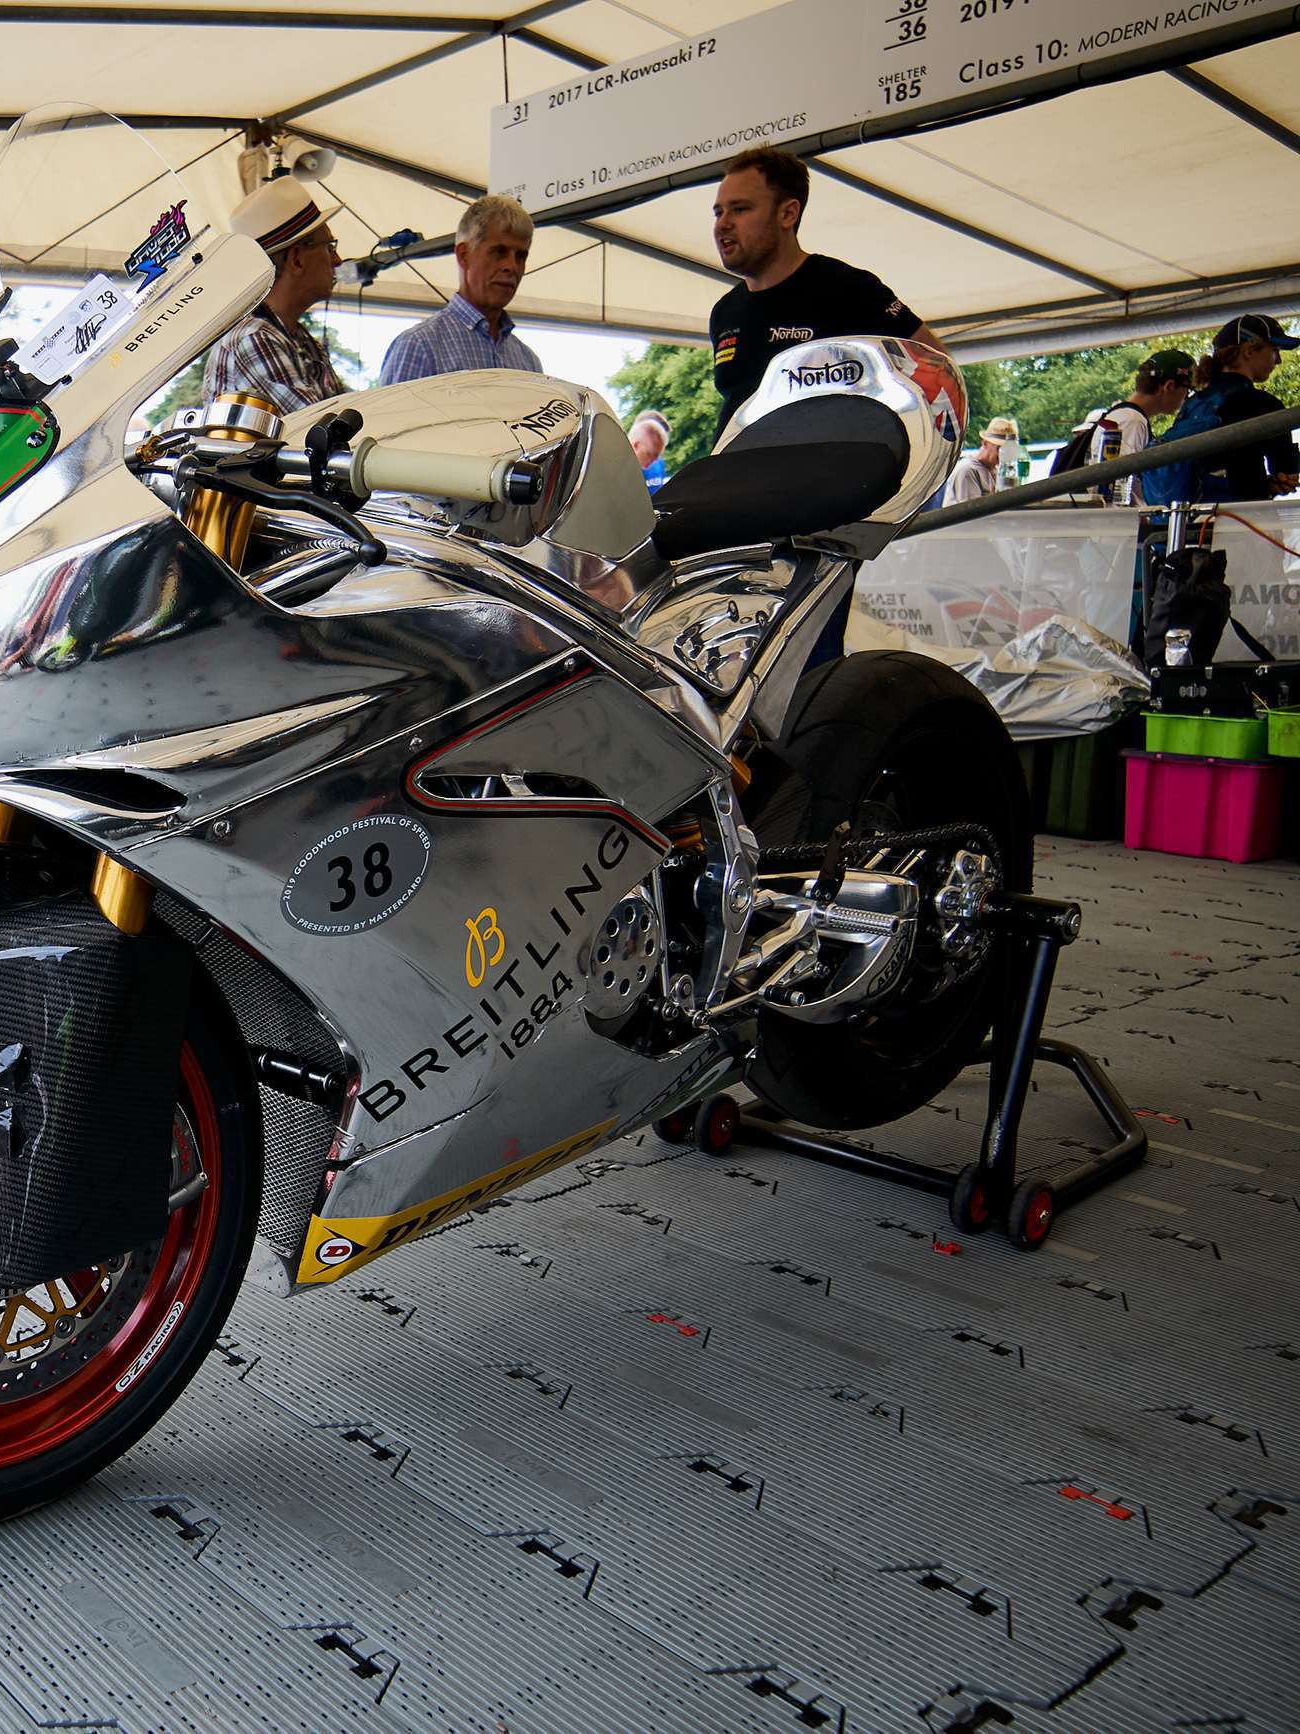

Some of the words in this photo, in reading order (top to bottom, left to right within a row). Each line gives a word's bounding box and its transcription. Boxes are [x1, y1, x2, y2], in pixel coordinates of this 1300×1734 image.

[898, 16, 927, 41] 36
[959, 55, 1024, 83] Class
[1035, 39, 1069, 63] 10:
[1077, 16, 1159, 52] MODERN
[1163, 0, 1239, 29] RACING
[549, 85, 583, 109] 2017
[587, 46, 692, 95] LCR-Kawasaki
[698, 38, 717, 57] F2
[878, 65, 927, 87] SHELTER
[883, 79, 922, 104] 185
[513, 102, 529, 121] 31
[545, 178, 585, 198] Class
[592, 167, 611, 184] 10:
[616, 153, 667, 178] MODERN
[668, 140, 713, 162] RACING
[715, 112, 807, 149] MOTORCYCLES
[96, 290, 119, 310] 38
[125, 286, 204, 352] BREITLING
[769, 327, 813, 342] Norton
[781, 360, 864, 394] Norton
[511, 399, 580, 441] Norton
[282, 878, 297, 900] 2019
[294, 826, 350, 875] GOODWOOD
[352, 816, 397, 831] FESTIVAL
[399, 818, 411, 828] OF
[411, 823, 431, 850] SPEED
[327, 842, 393, 912] 38
[297, 918, 350, 933] PRESENTED
[354, 921, 366, 930] BY
[369, 876, 422, 924] MASTERCARD
[356, 825, 630, 1123] BREITLING
[500, 970, 573, 1060] 1884
[144, 1314, 176, 1361] RACING
